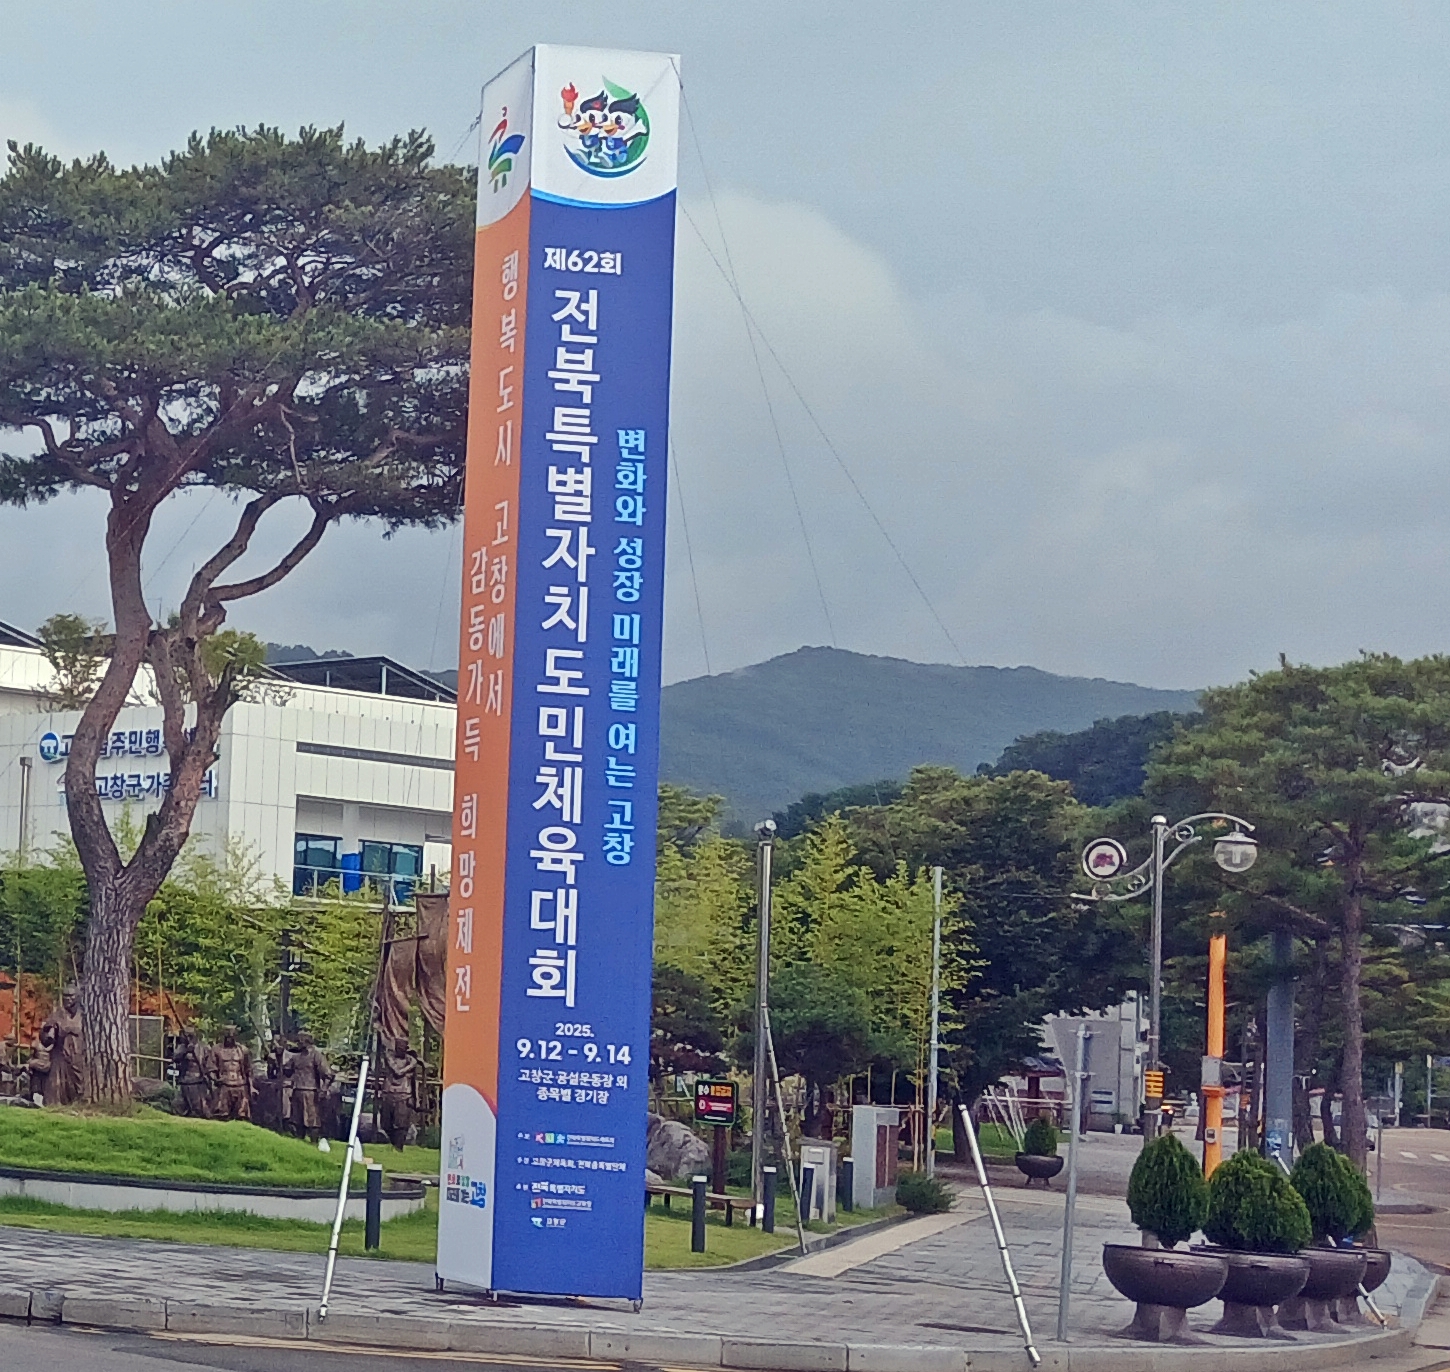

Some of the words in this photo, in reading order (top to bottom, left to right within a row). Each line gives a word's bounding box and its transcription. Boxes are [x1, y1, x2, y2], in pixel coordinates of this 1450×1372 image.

[544, 247, 623, 276] 제62회
[494, 250, 519, 466] 행복도시
[614, 428, 647, 526] 변화와
[612, 537, 643, 602] 성장
[463, 546, 489, 762] 감동가득
[526, 289, 601, 1008] 전북특별자치도민체육대회
[608, 613, 641, 711] 미래를
[604, 722, 636, 788] 여는
[602, 800, 635, 866] 고창
[454, 793, 479, 1012] 희망체전
[516, 1038, 563, 1060] 9.12
[555, 1022, 595, 1037] 2025.
[518, 1068, 554, 1084] 고창군
[574, 1089, 609, 1104] 경기장
